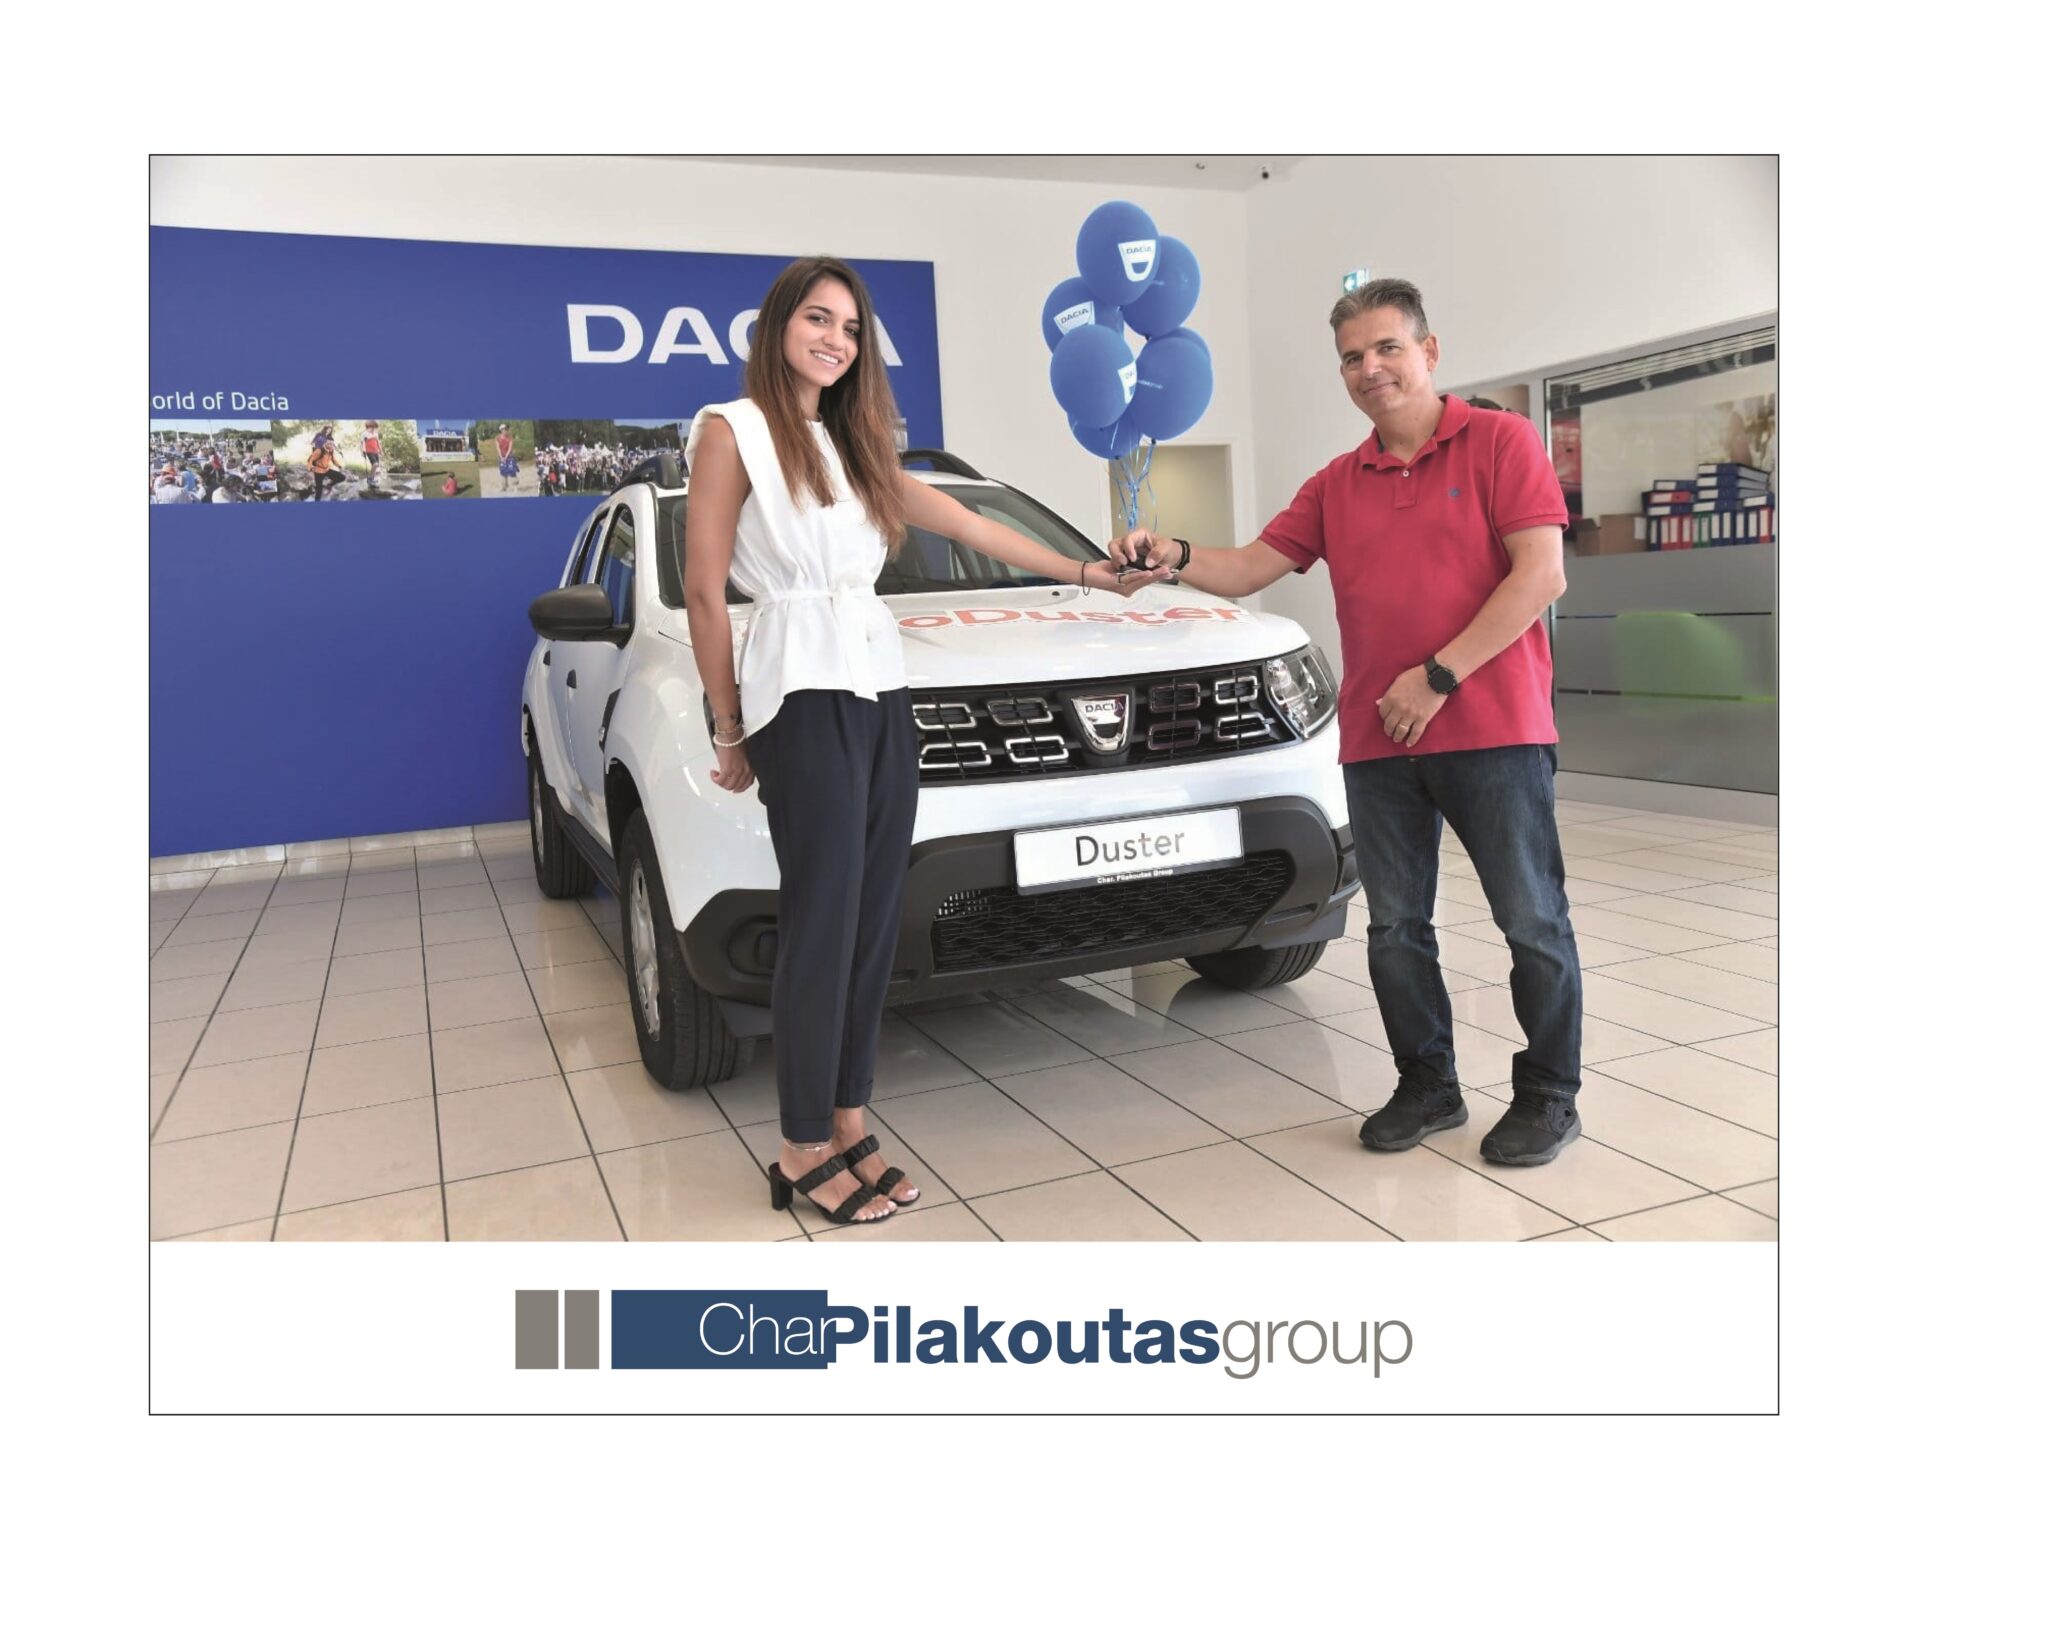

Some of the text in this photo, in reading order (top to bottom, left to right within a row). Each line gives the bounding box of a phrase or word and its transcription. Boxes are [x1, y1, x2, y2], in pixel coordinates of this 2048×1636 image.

[1126, 246, 1152, 255] DACIA
[1060, 308, 1089, 323] DACIA
[152, 391, 289, 411] orld of Dacia
[898, 606, 1242, 629] oDuster
[1075, 832, 1185, 867] Duster
[1153, 869, 1173, 877] Group
